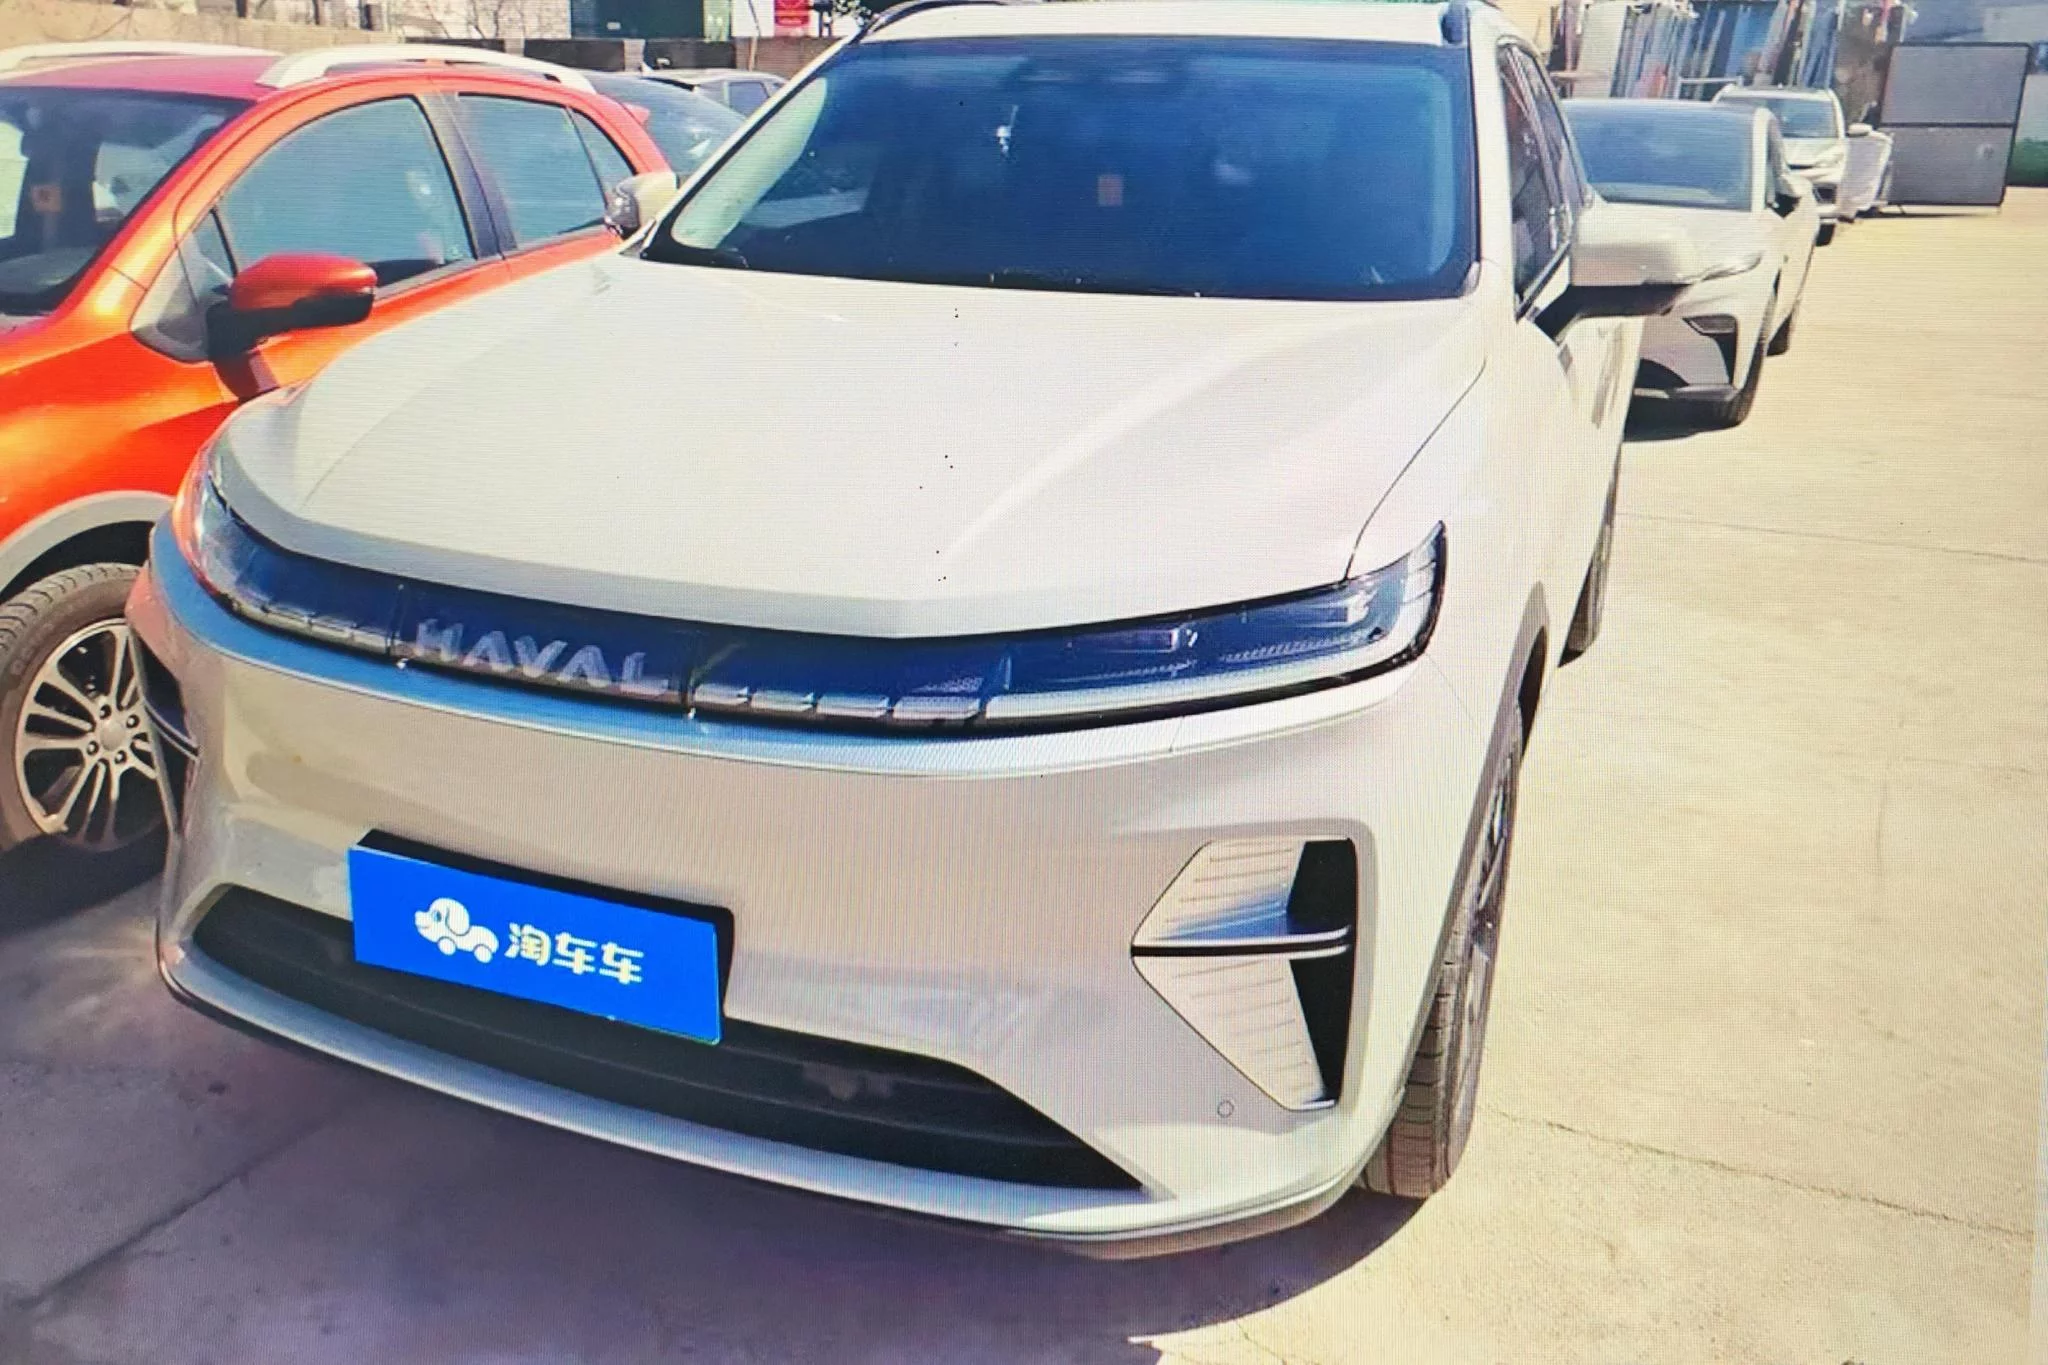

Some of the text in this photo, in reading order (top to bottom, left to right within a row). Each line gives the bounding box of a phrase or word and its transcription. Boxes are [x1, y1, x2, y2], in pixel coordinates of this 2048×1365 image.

[414, 618, 668, 694] HAVAL
[504, 922, 644, 984] 淘车车
